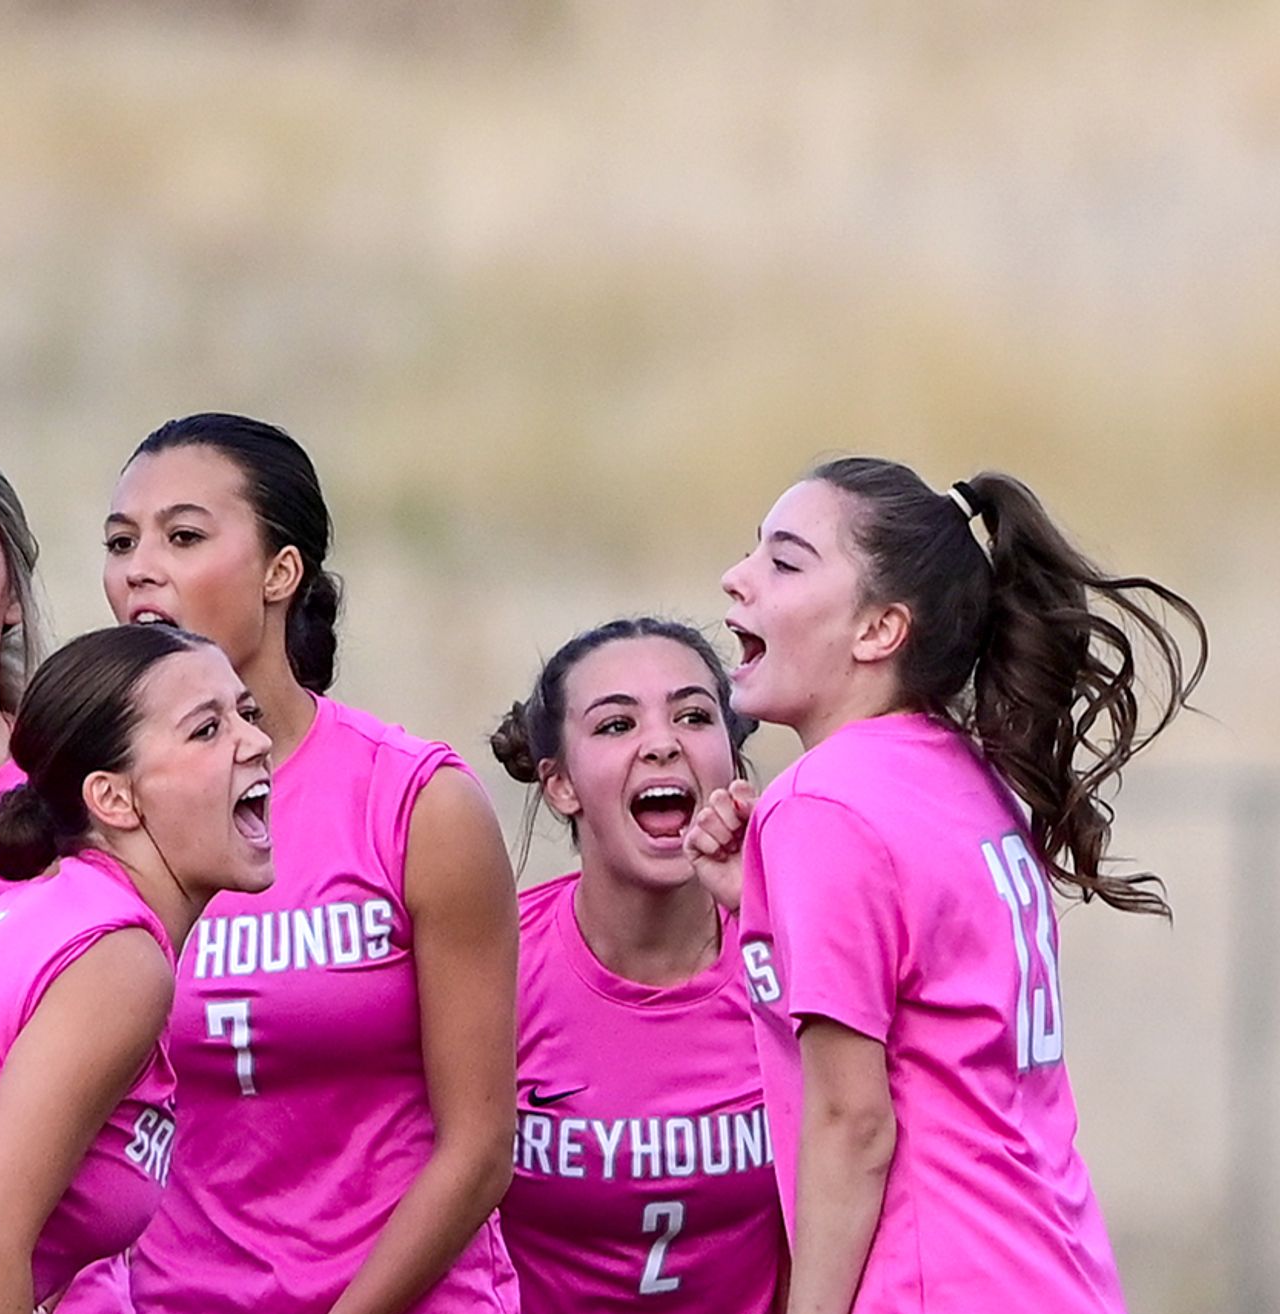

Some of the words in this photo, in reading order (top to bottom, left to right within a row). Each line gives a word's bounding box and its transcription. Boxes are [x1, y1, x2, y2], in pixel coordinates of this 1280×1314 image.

[193, 897, 391, 979] HOUNDS
[740, 940, 781, 1003] S
[206, 1000, 257, 1097] 7
[124, 1107, 176, 1189] GR
[513, 1106, 774, 1181] REYHOUN
[639, 1200, 686, 1296] 2
